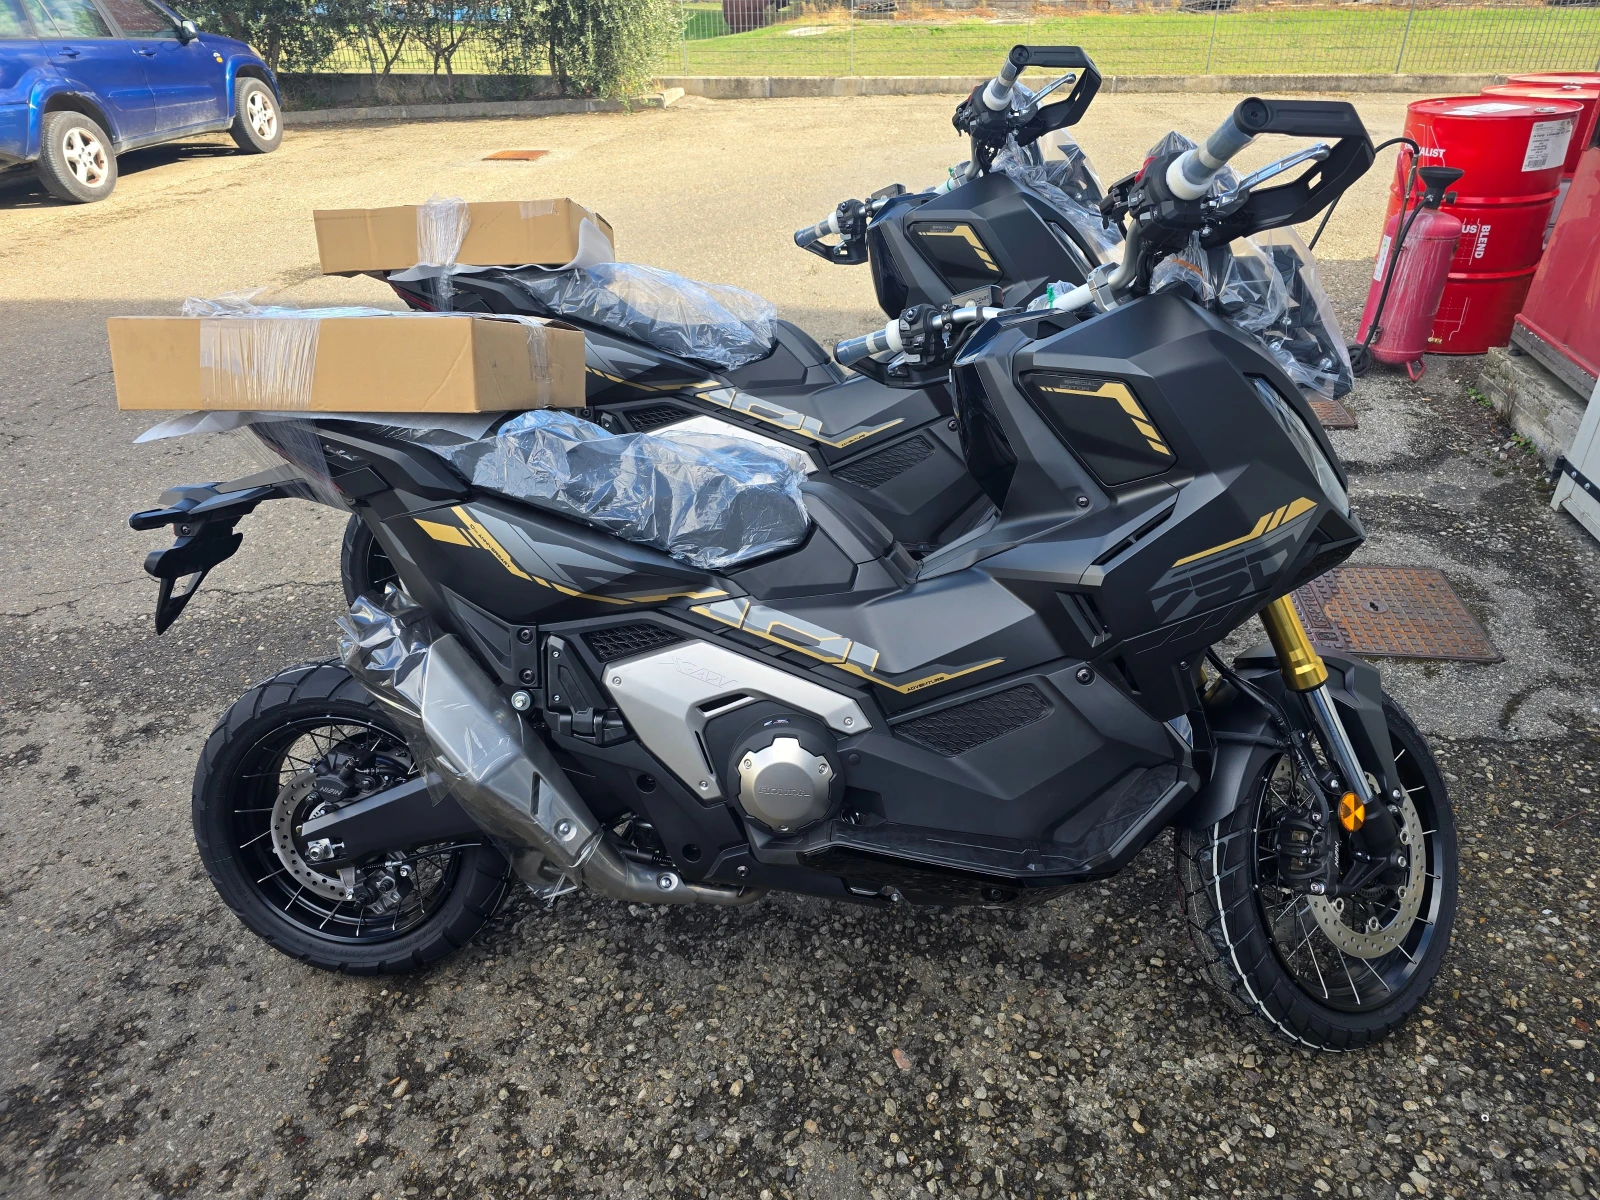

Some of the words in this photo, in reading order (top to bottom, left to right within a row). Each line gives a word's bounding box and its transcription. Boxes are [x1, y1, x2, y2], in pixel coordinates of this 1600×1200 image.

[1461, 224, 1478, 234] US
[1474, 224, 1491, 259] BLEND
[1064, 379, 1099, 387] SPECIAL
[477, 533, 512, 568] ANNIVERSARY
[906, 675, 946, 692] ADVENTURE
[758, 785, 811, 798] HONDA
